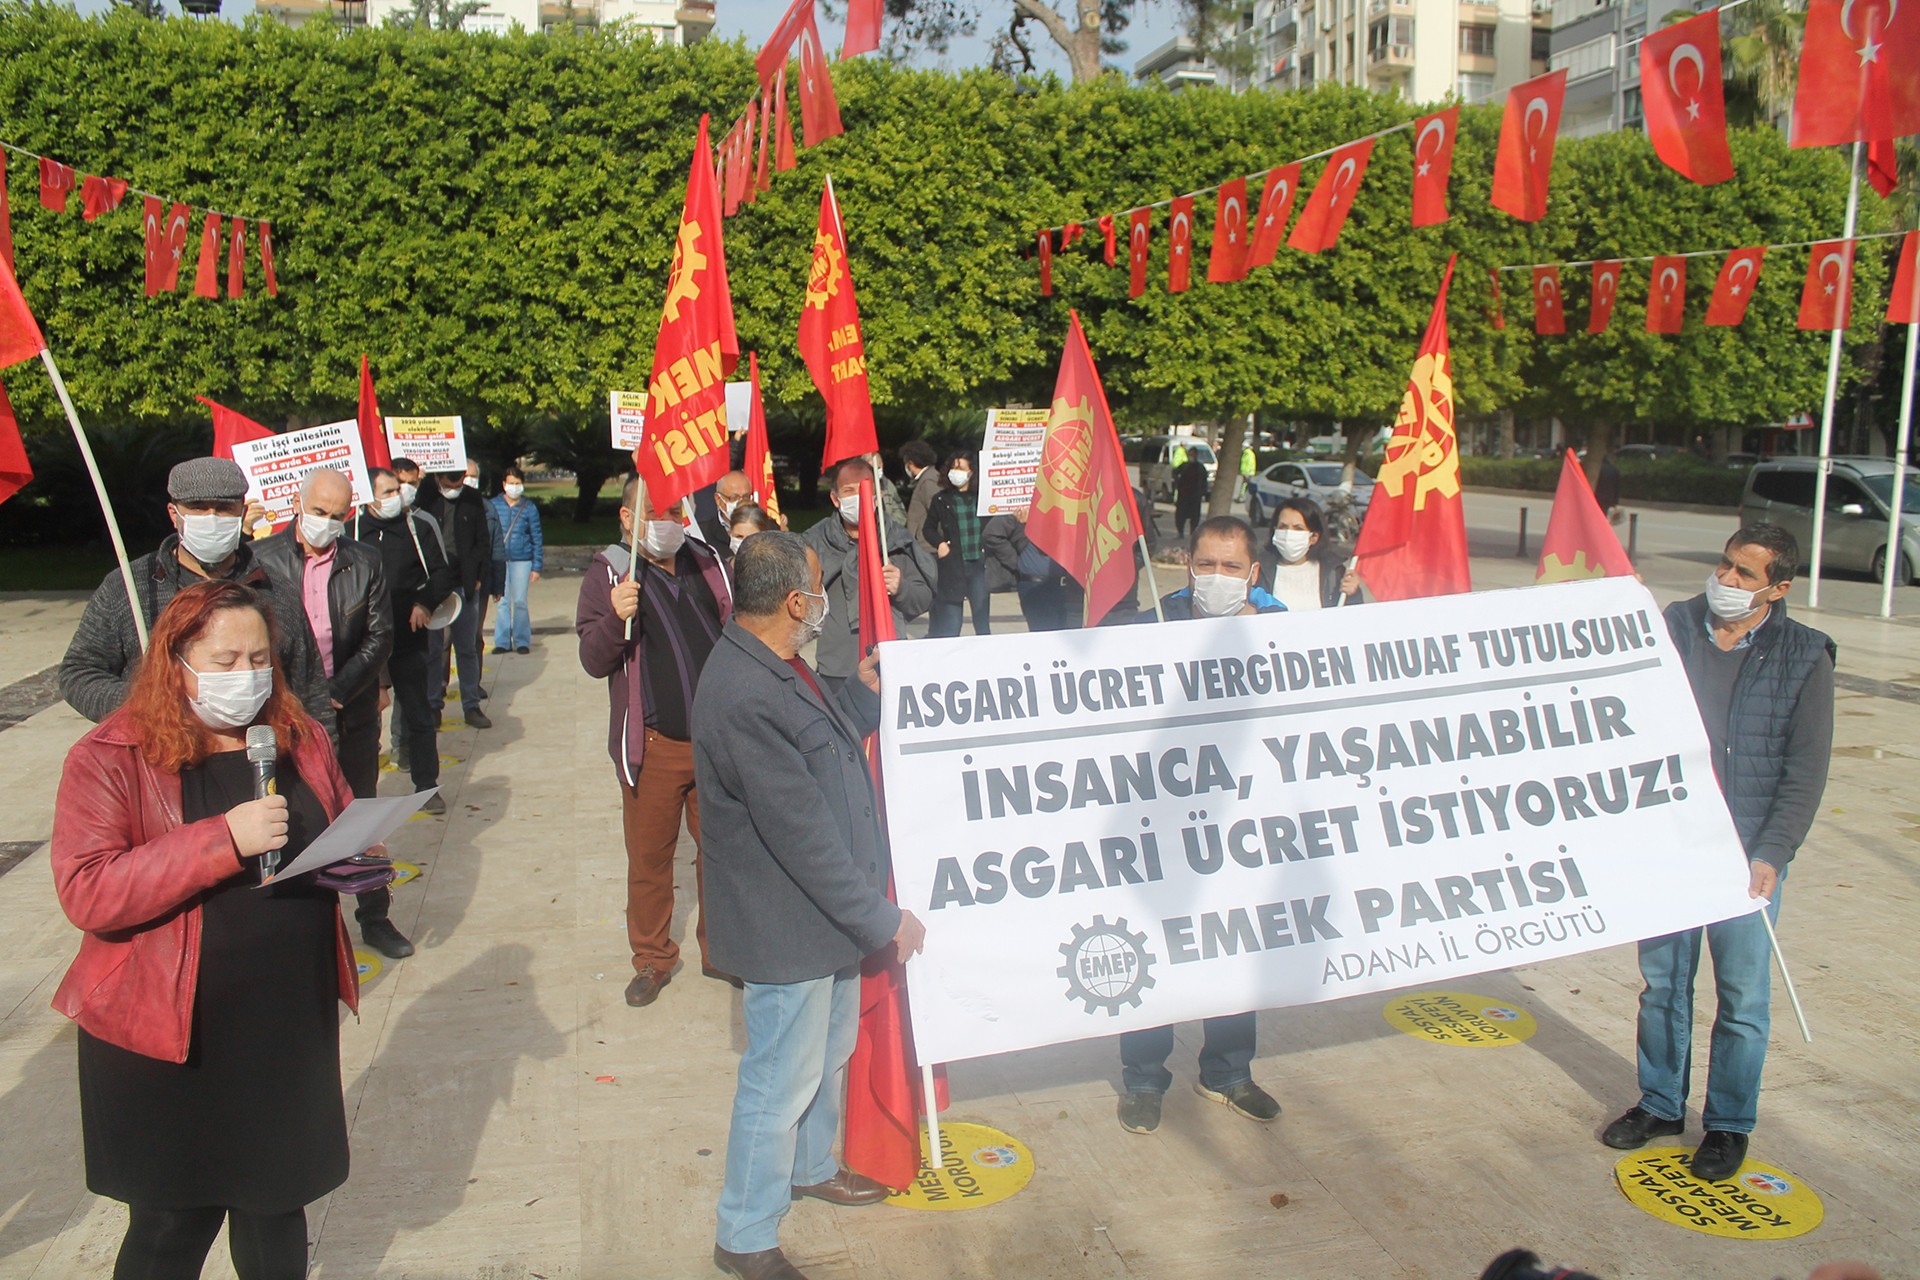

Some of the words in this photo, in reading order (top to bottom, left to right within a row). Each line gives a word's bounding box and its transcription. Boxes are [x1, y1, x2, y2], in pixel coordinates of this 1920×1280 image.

[251, 443, 269, 453] Bir
[272, 436, 290, 450] işçi
[293, 427, 341, 442] ailesinin
[253, 465, 270, 475] son
[271, 461, 278, 470] 6
[279, 456, 302, 470] ayda
[315, 450, 327, 461] 57
[328, 447, 349, 459] arttı
[254, 448, 290, 462] mutfak
[293, 438, 344, 454] masrafları
[259, 471, 297, 488] İNSANCA,
[897, 662, 1039, 730] ASGARİ
[1050, 659, 1165, 715] ÜCRET
[1174, 641, 1355, 702] VERGİDEN
[1365, 633, 1462, 682] MUAF
[1469, 609, 1656, 669] TUTULSUN!
[962, 754, 1253, 822] İNSANCA,
[1262, 686, 1636, 787] YAŞANABİLİR
[928, 816, 1164, 911] ASGARİ
[1181, 805, 1360, 875] ÜCRET
[1378, 754, 1688, 848] İSTİYORUZ!
[1161, 894, 1343, 966] EMEK
[1354, 844, 1588, 934] PARTİSİ
[1080, 952, 1137, 979] EMEP
[1322, 942, 1436, 985] ADANA
[1438, 930, 1469, 962] İL
[1475, 905, 1606, 955] ÖRGÜTÜ
[1396, 1005, 1452, 1040] SOSYAL
[1406, 998, 1484, 1042] MESAFEYİ
[1433, 996, 1510, 1040] KORUYUN
[1629, 1169, 1717, 1227] SOSYAL
[1638, 1158, 1760, 1231] MESAFEYİ
[1671, 1153, 1791, 1227] KORUN
